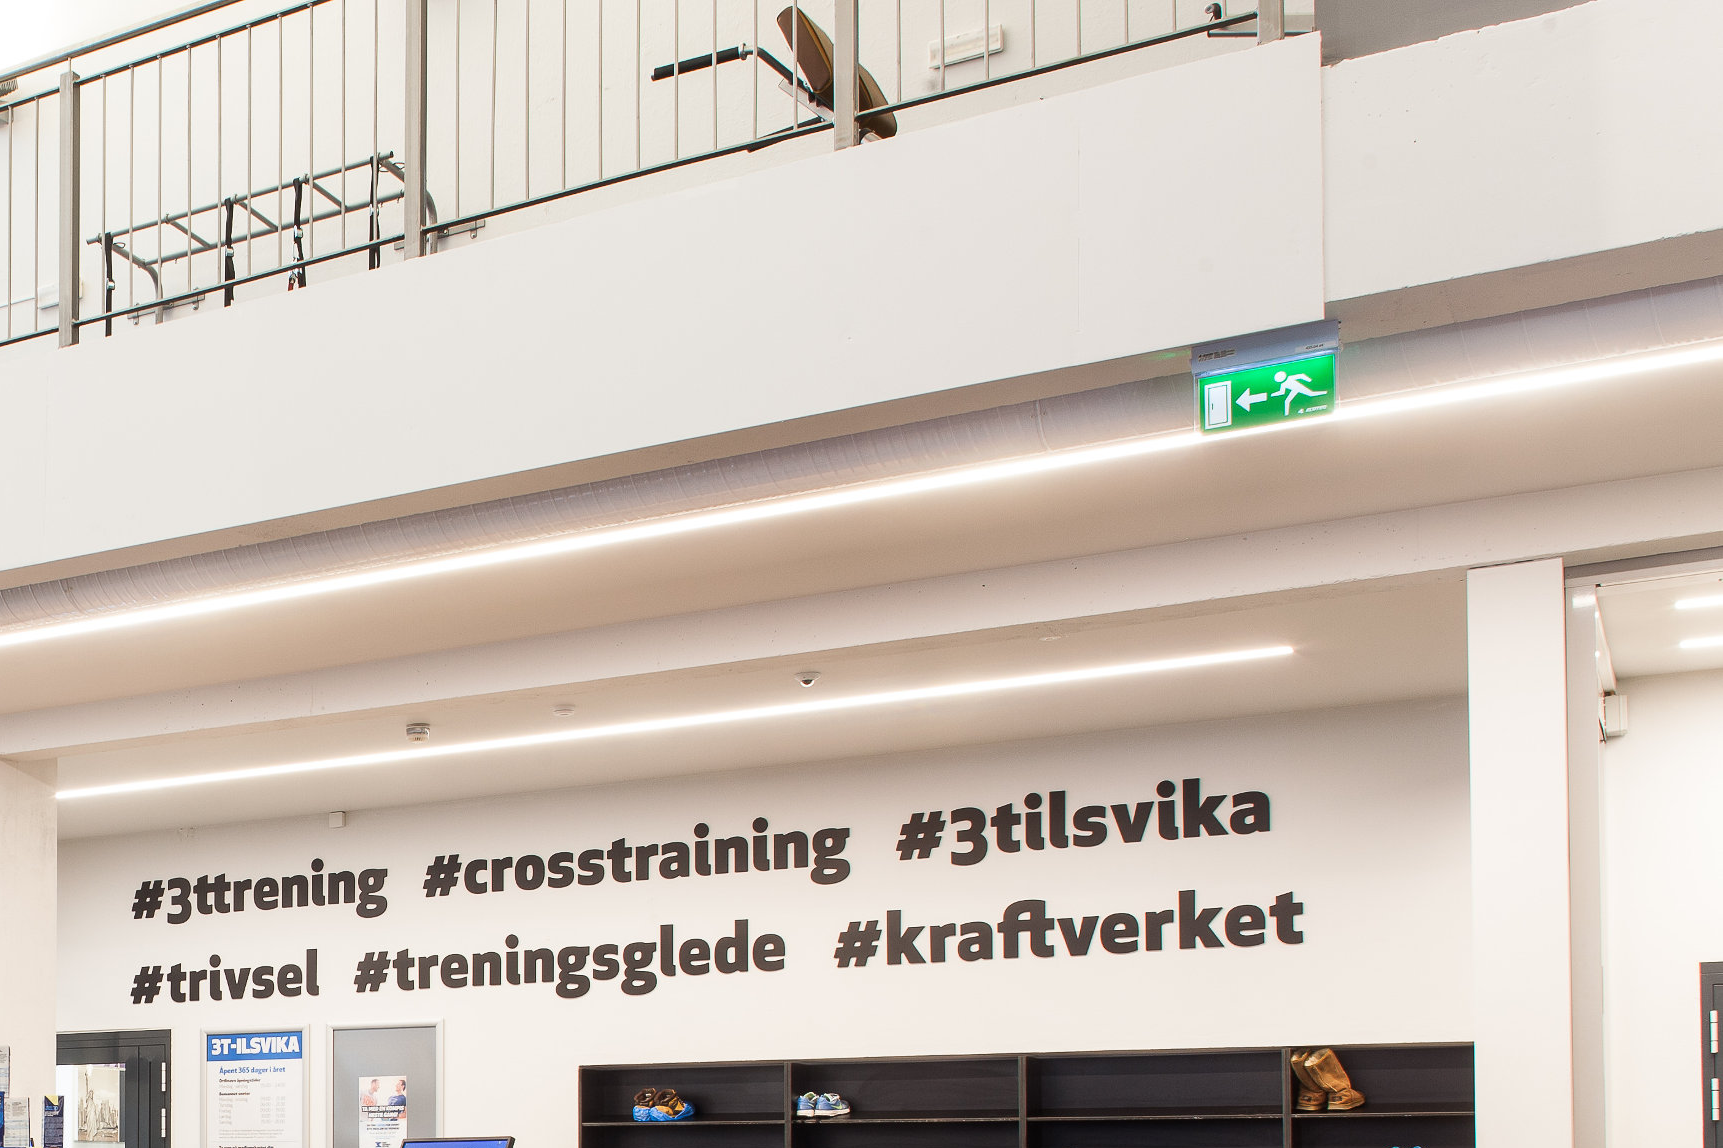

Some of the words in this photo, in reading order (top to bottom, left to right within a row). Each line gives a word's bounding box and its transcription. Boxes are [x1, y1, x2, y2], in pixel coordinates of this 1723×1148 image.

[132, 858, 387, 924] #3ttrening
[423, 817, 850, 897] #crosstraining
[896, 778, 1270, 865] #3tilsvika
[131, 949, 319, 1004] #trivsel
[354, 919, 785, 998] #treningsglede
[834, 890, 1303, 967] #kraftverket
[211, 1036, 300, 1055] 3T-ILSVIKA
[219, 1066, 238, 1075] Åpent
